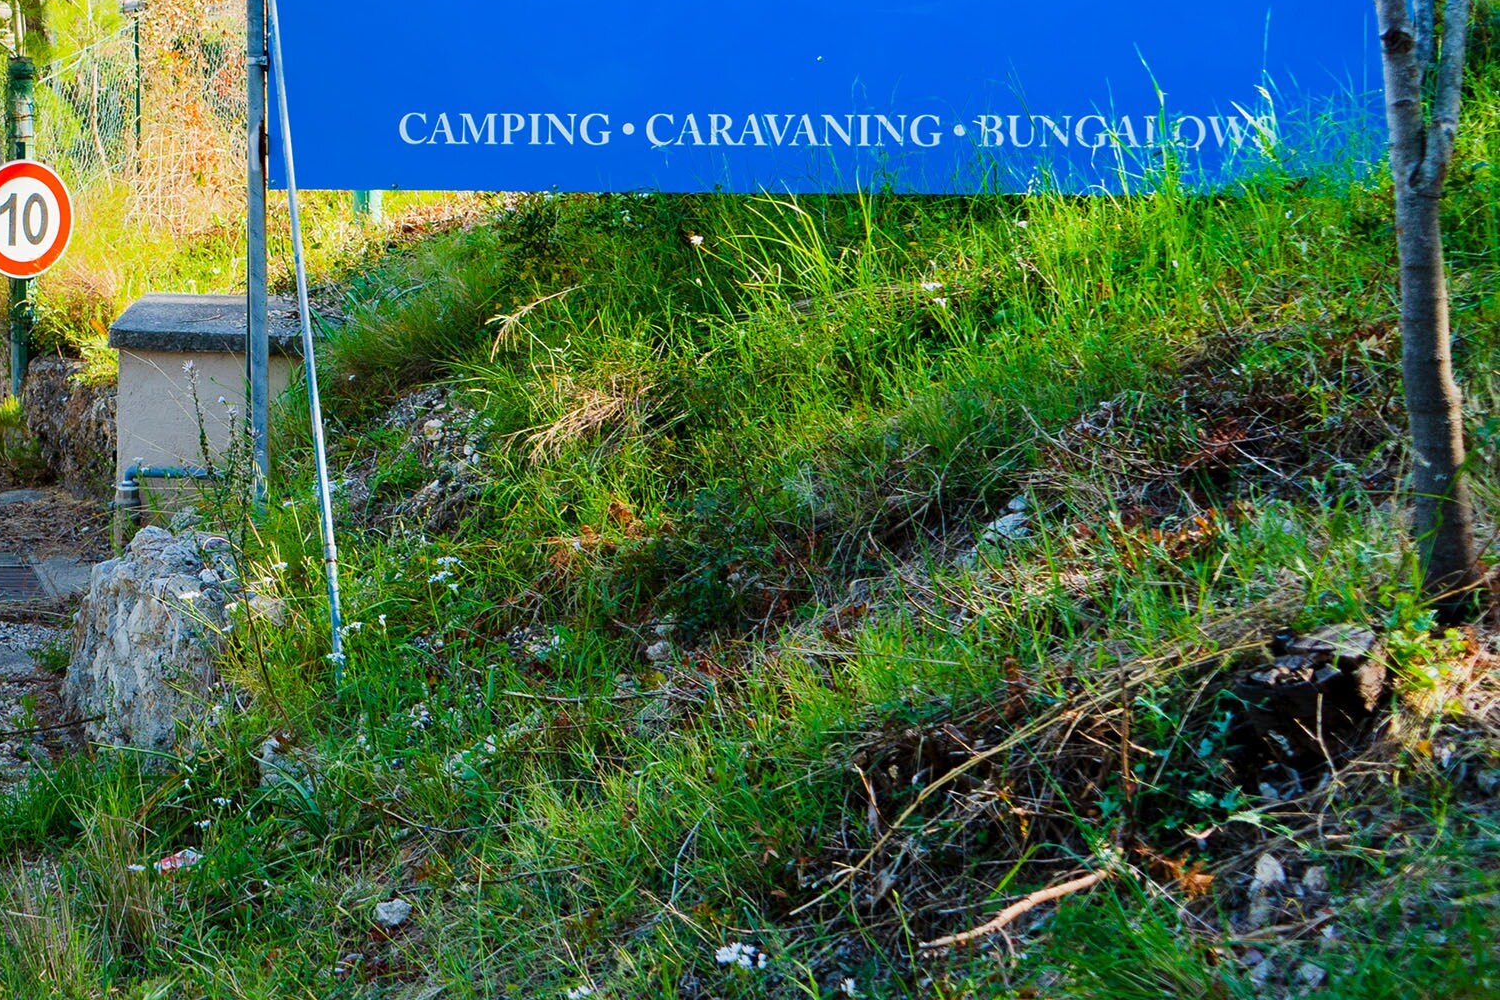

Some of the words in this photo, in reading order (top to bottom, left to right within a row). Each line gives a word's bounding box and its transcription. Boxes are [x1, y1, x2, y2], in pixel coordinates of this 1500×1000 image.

[398, 112, 612, 146] CAMPING
[645, 113, 942, 148] CARAVANING
[0, 192, 49, 246] 10
